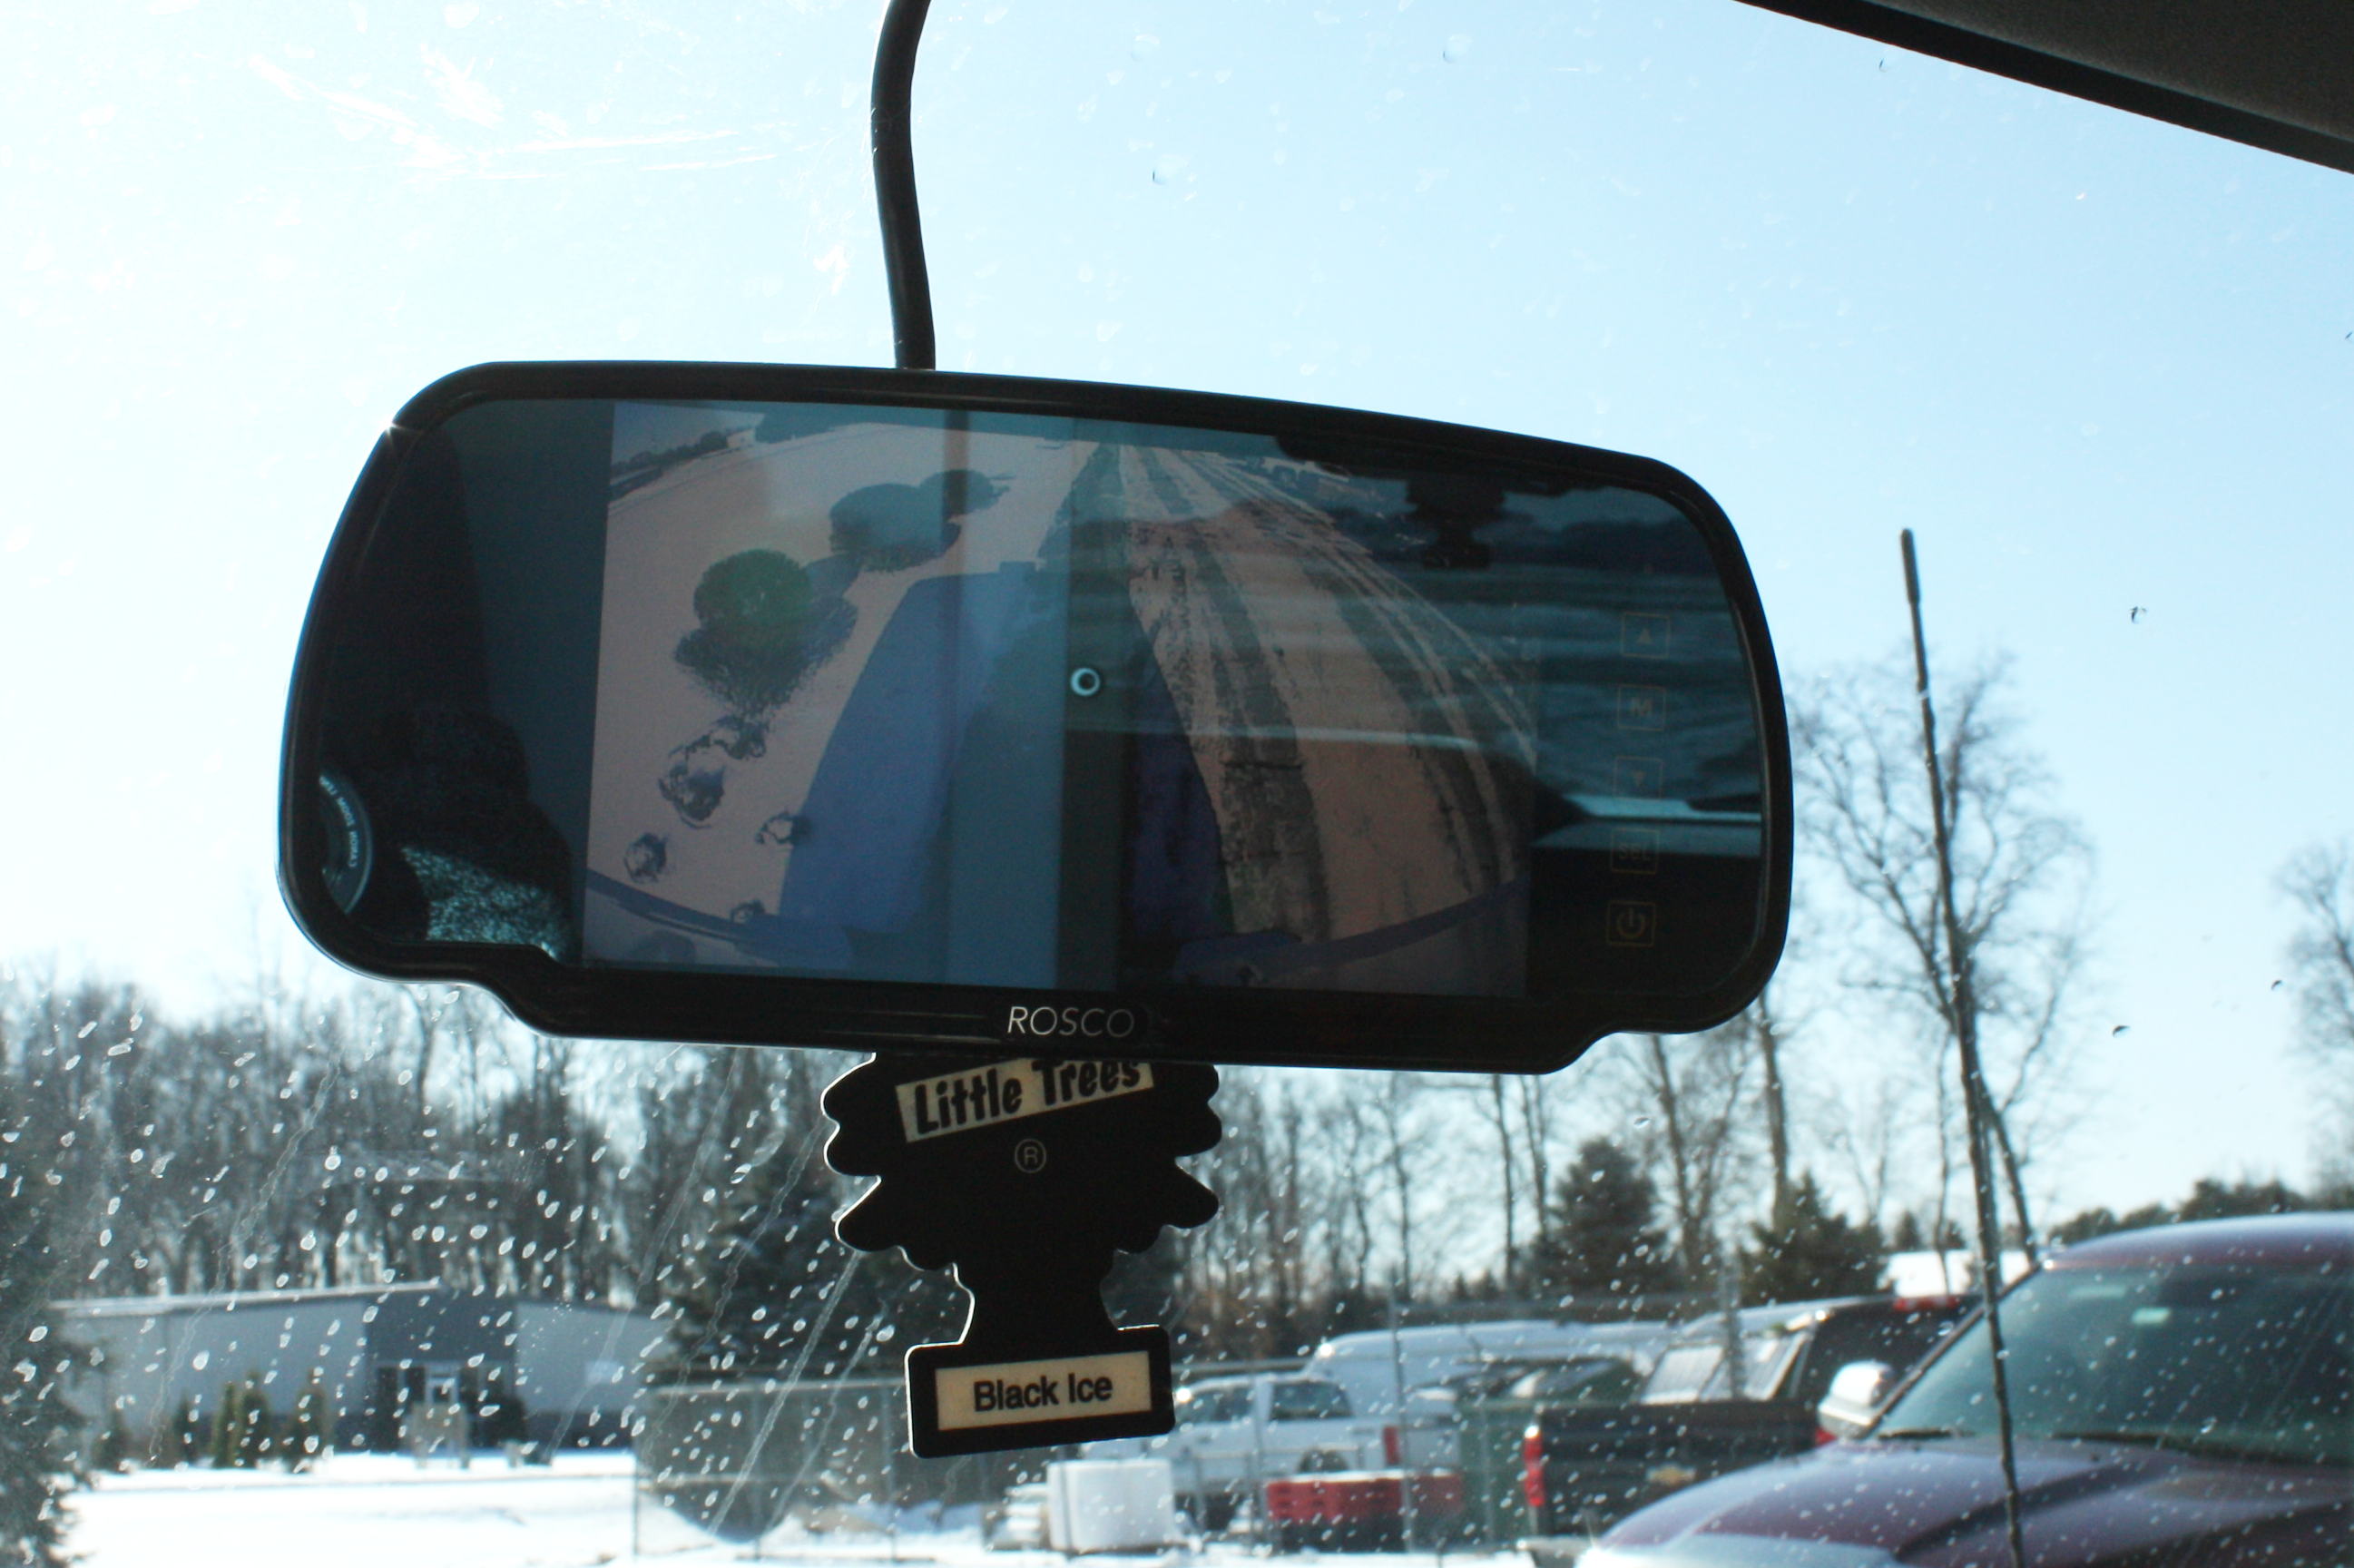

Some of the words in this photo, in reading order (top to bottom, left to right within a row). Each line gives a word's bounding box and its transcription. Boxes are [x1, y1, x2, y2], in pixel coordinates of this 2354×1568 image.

[1619, 841, 1651, 860] SEL
[1007, 1005, 1134, 1038] ROSCO
[913, 1067, 1024, 1135] Little
[1031, 1058, 1142, 1107] Trees
[974, 1375, 1060, 1412] Black
[1067, 1371, 1113, 1404] Ice
